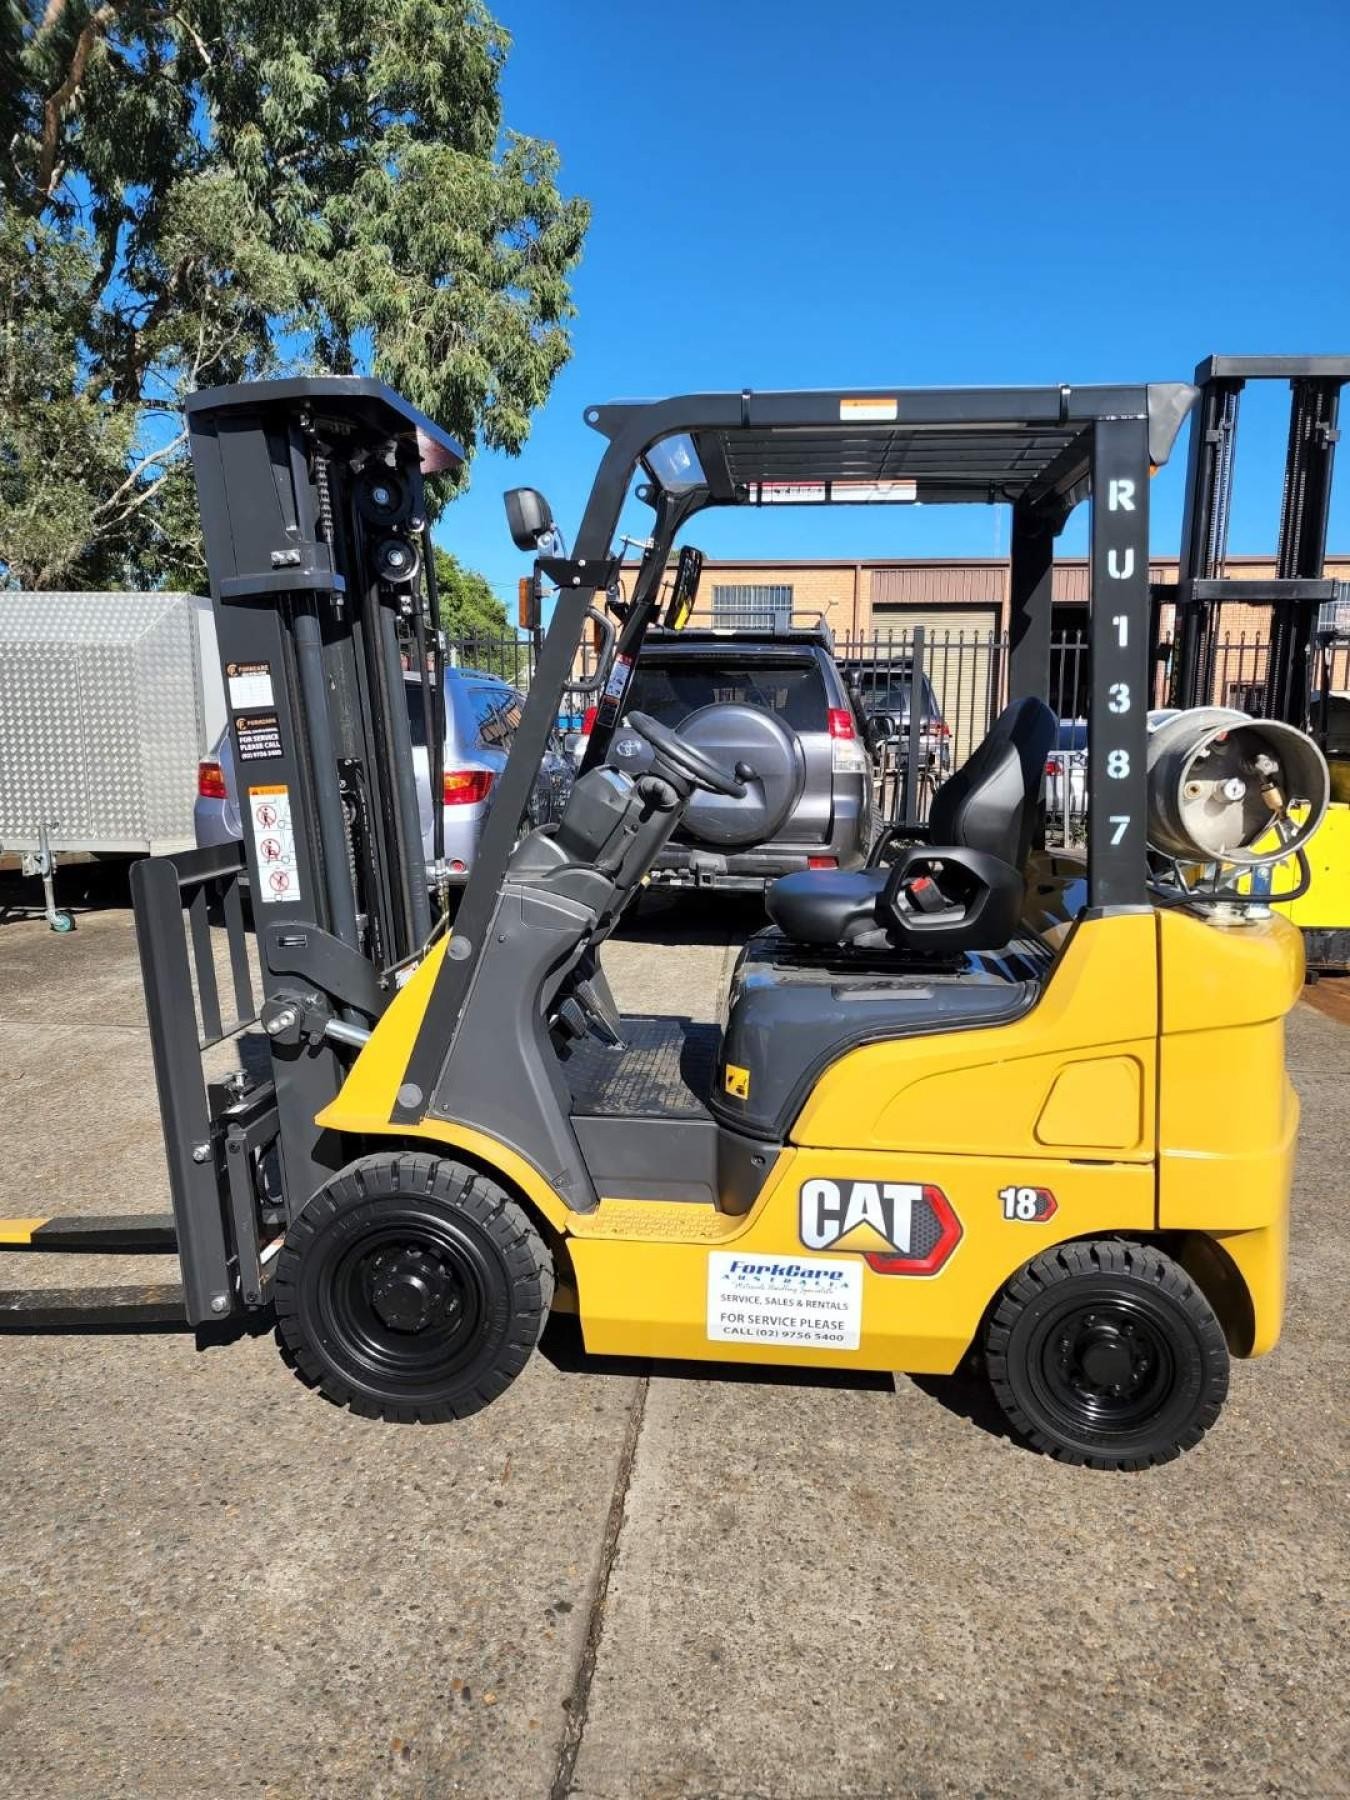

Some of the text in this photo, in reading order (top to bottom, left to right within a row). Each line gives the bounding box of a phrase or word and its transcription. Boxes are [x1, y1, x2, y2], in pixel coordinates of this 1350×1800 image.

[1000, 1187, 1037, 1220] 18
[801, 1179, 923, 1253] CAT
[730, 1260, 844, 1281] ForkCare
[764, 1296, 794, 1307] SALES
[796, 1299, 803, 1308] &
[805, 1300, 848, 1311] RENTALS
[720, 1313, 845, 1331] FOR SERVICE PLEASE
[723, 1326, 845, 1342] CALL (02) 9756 5400
